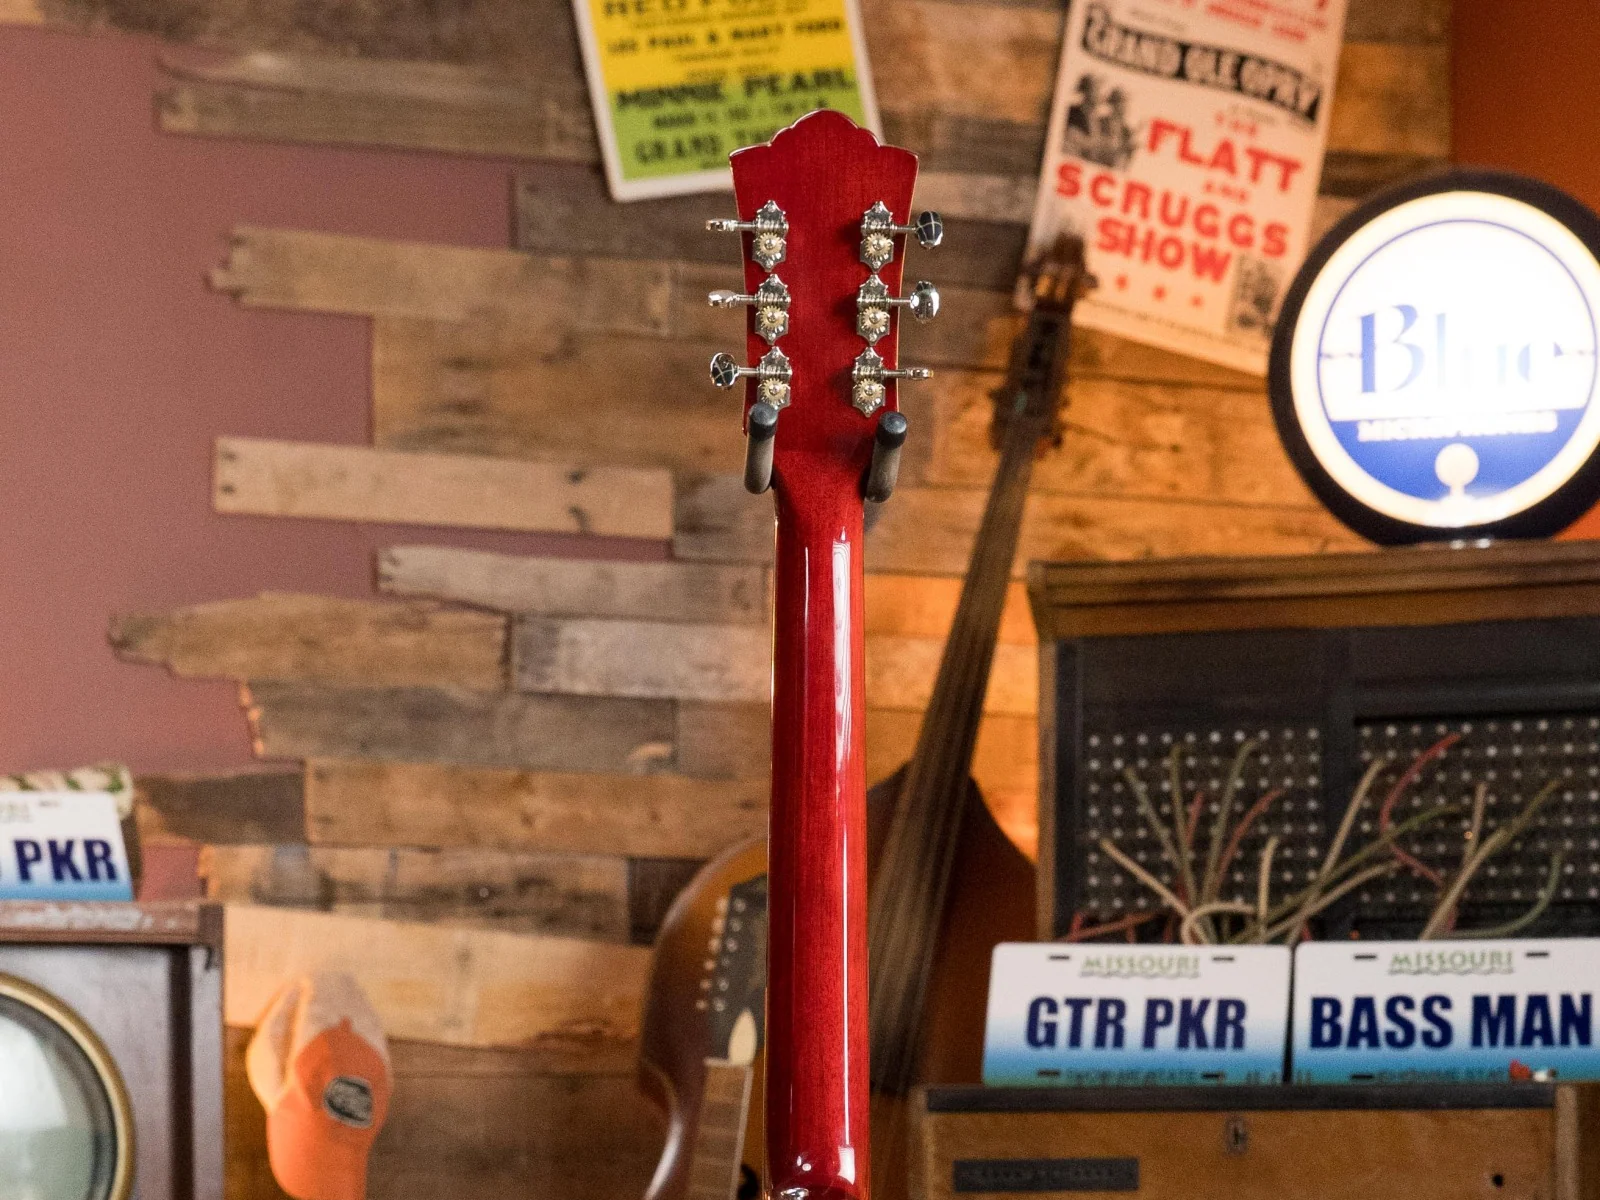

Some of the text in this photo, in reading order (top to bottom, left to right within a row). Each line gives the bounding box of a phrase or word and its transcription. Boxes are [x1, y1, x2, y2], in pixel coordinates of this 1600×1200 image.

[1147, 117, 1304, 194] FLATT
[1055, 161, 1291, 259] SCRUGGS
[1096, 216, 1234, 285] SHOW
[14, 839, 118, 883] PKR
[1081, 954, 1200, 974] MISSOURI
[1390, 951, 1513, 973] MISSOURI
[1025, 996, 1248, 1051] GTR PKR
[1308, 994, 1594, 1050] BASS MAN
